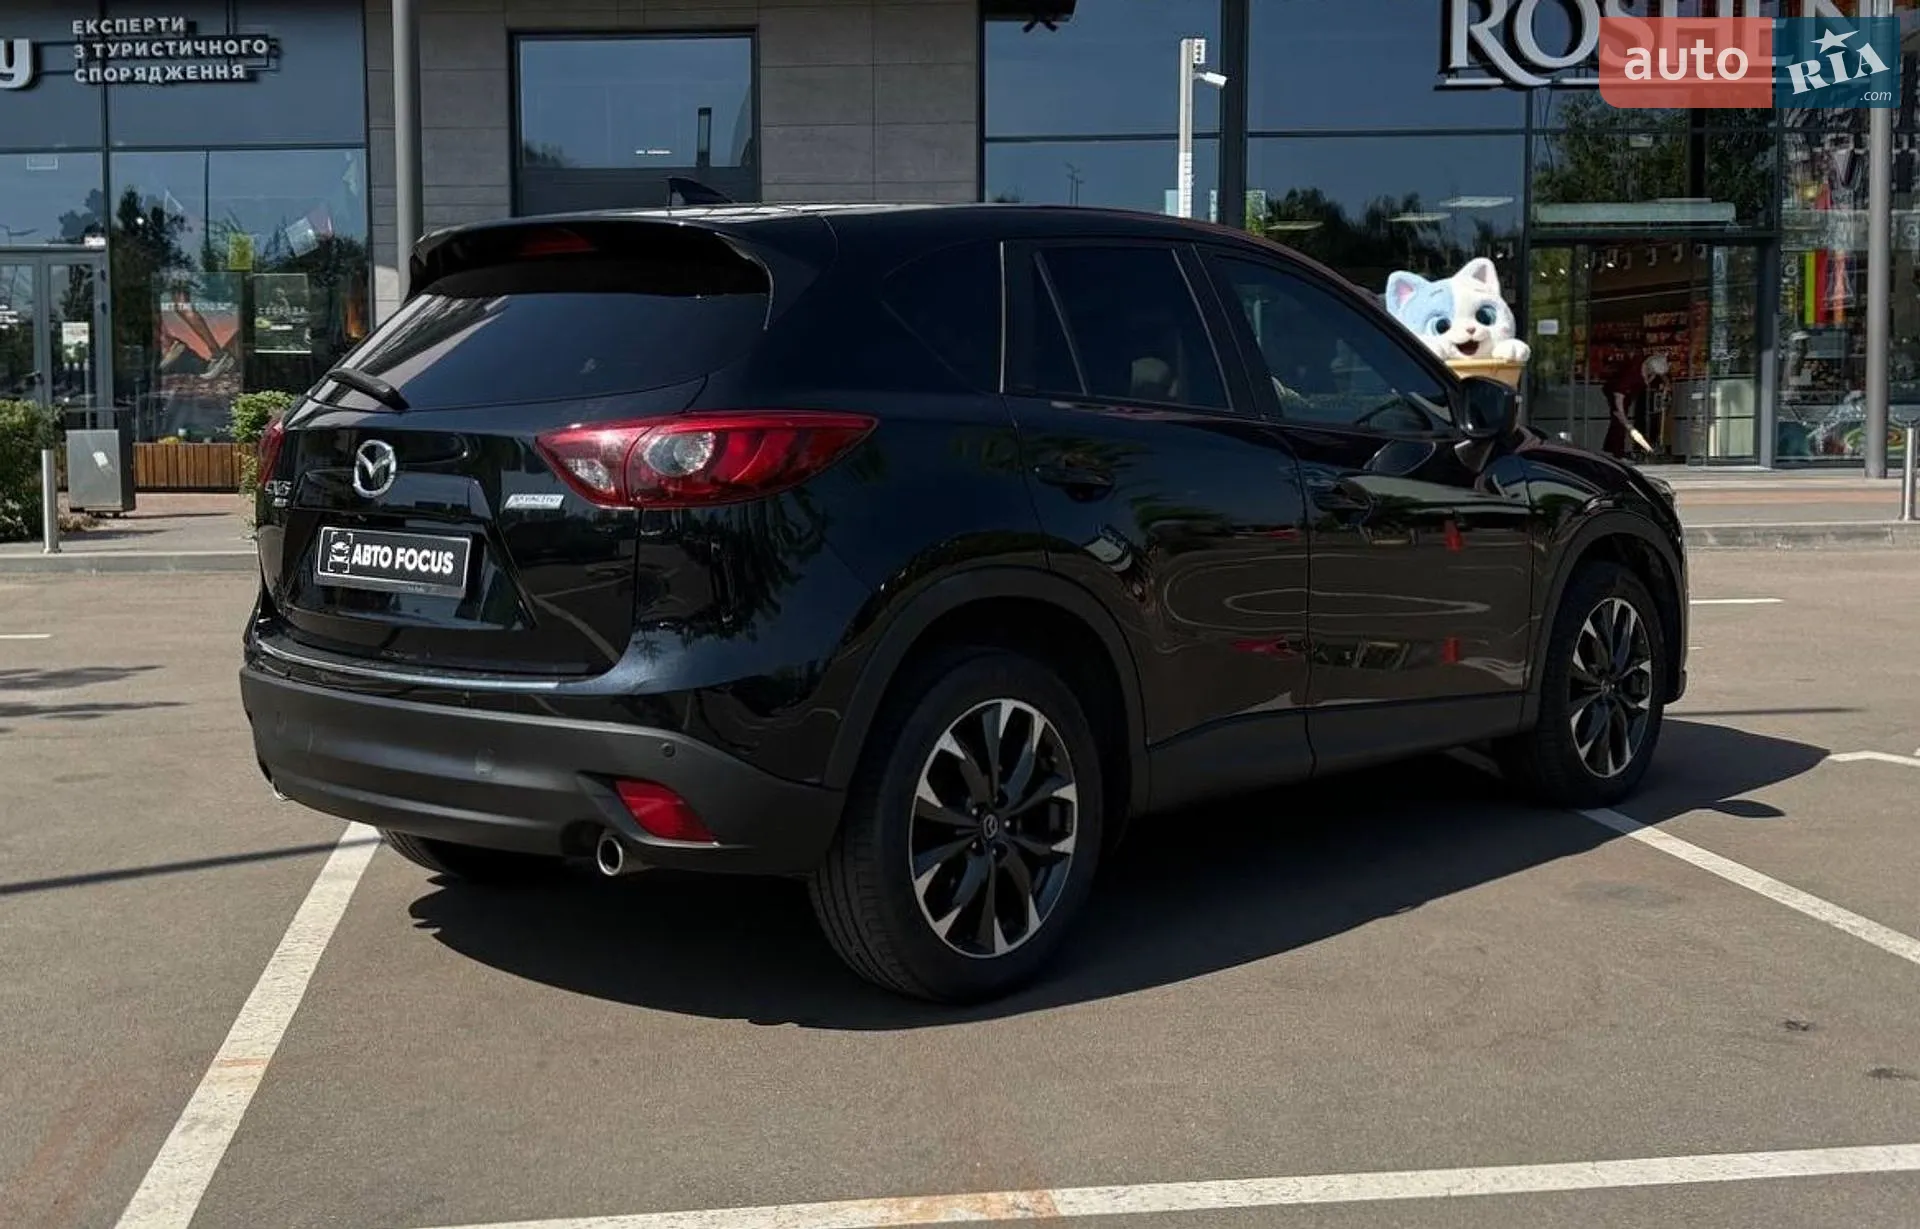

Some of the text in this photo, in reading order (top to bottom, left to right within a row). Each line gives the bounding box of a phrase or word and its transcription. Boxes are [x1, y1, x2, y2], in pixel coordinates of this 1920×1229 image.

[72, 16, 185, 35] ЕКСПЕРТИ
[92, 39, 268, 57] ТУРИСТИЧНОГО
[74, 64, 245, 83] СПОРЯДЖЕННЯ
[351, 543, 454, 575] АВТО FOCUS
